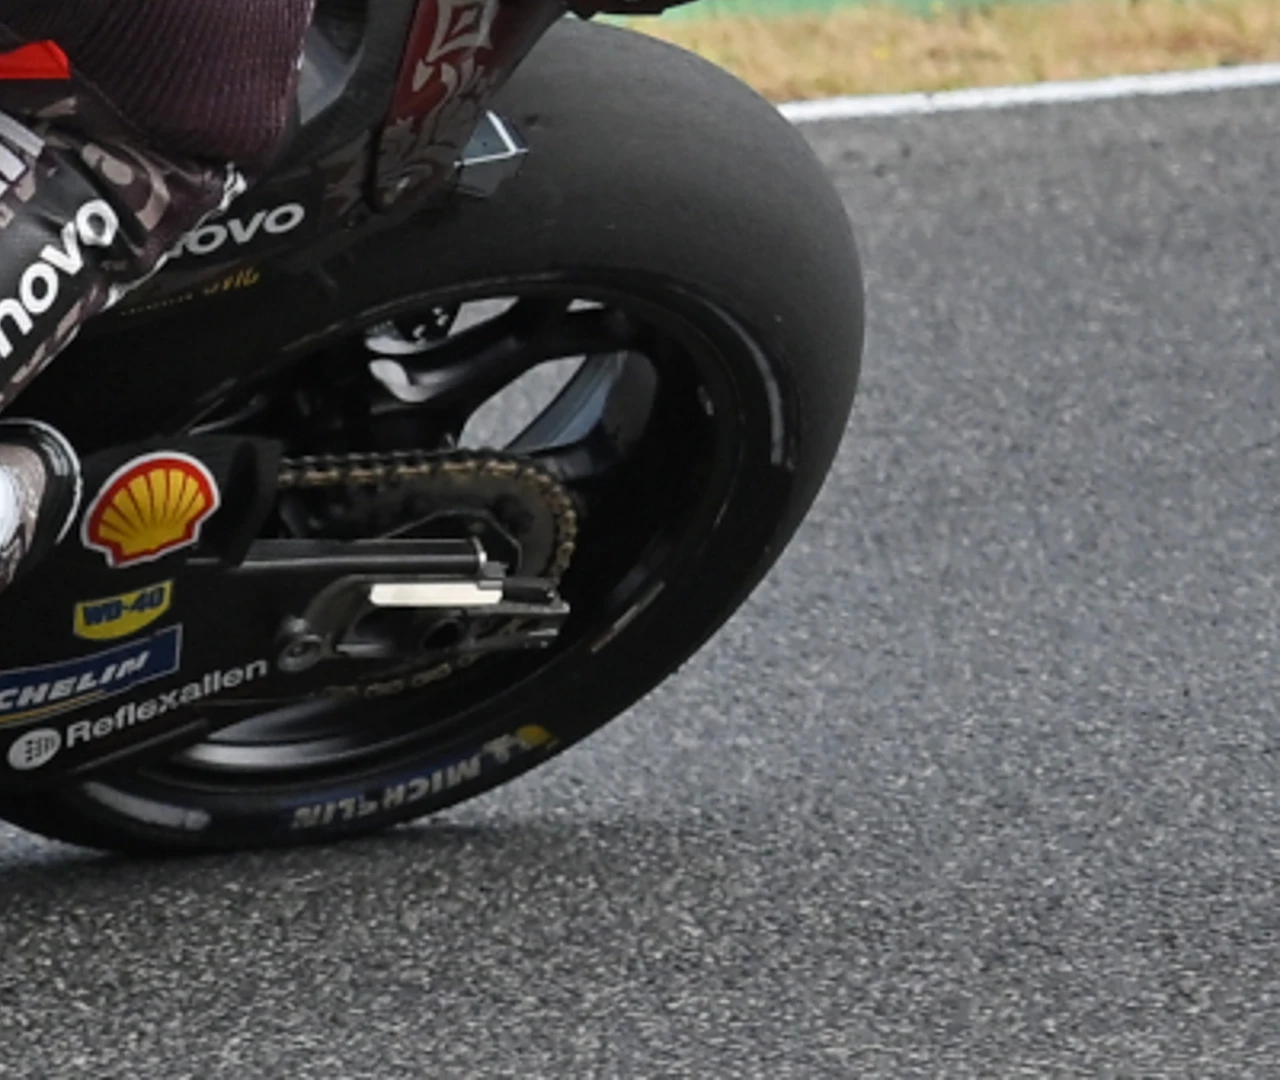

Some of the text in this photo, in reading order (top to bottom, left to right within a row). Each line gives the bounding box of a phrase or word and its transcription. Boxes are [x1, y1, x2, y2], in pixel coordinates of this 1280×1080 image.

[167, 202, 305, 257] ovo
[83, 587, 165, 626] WD-40
[66, 658, 269, 749] Reflexallen
